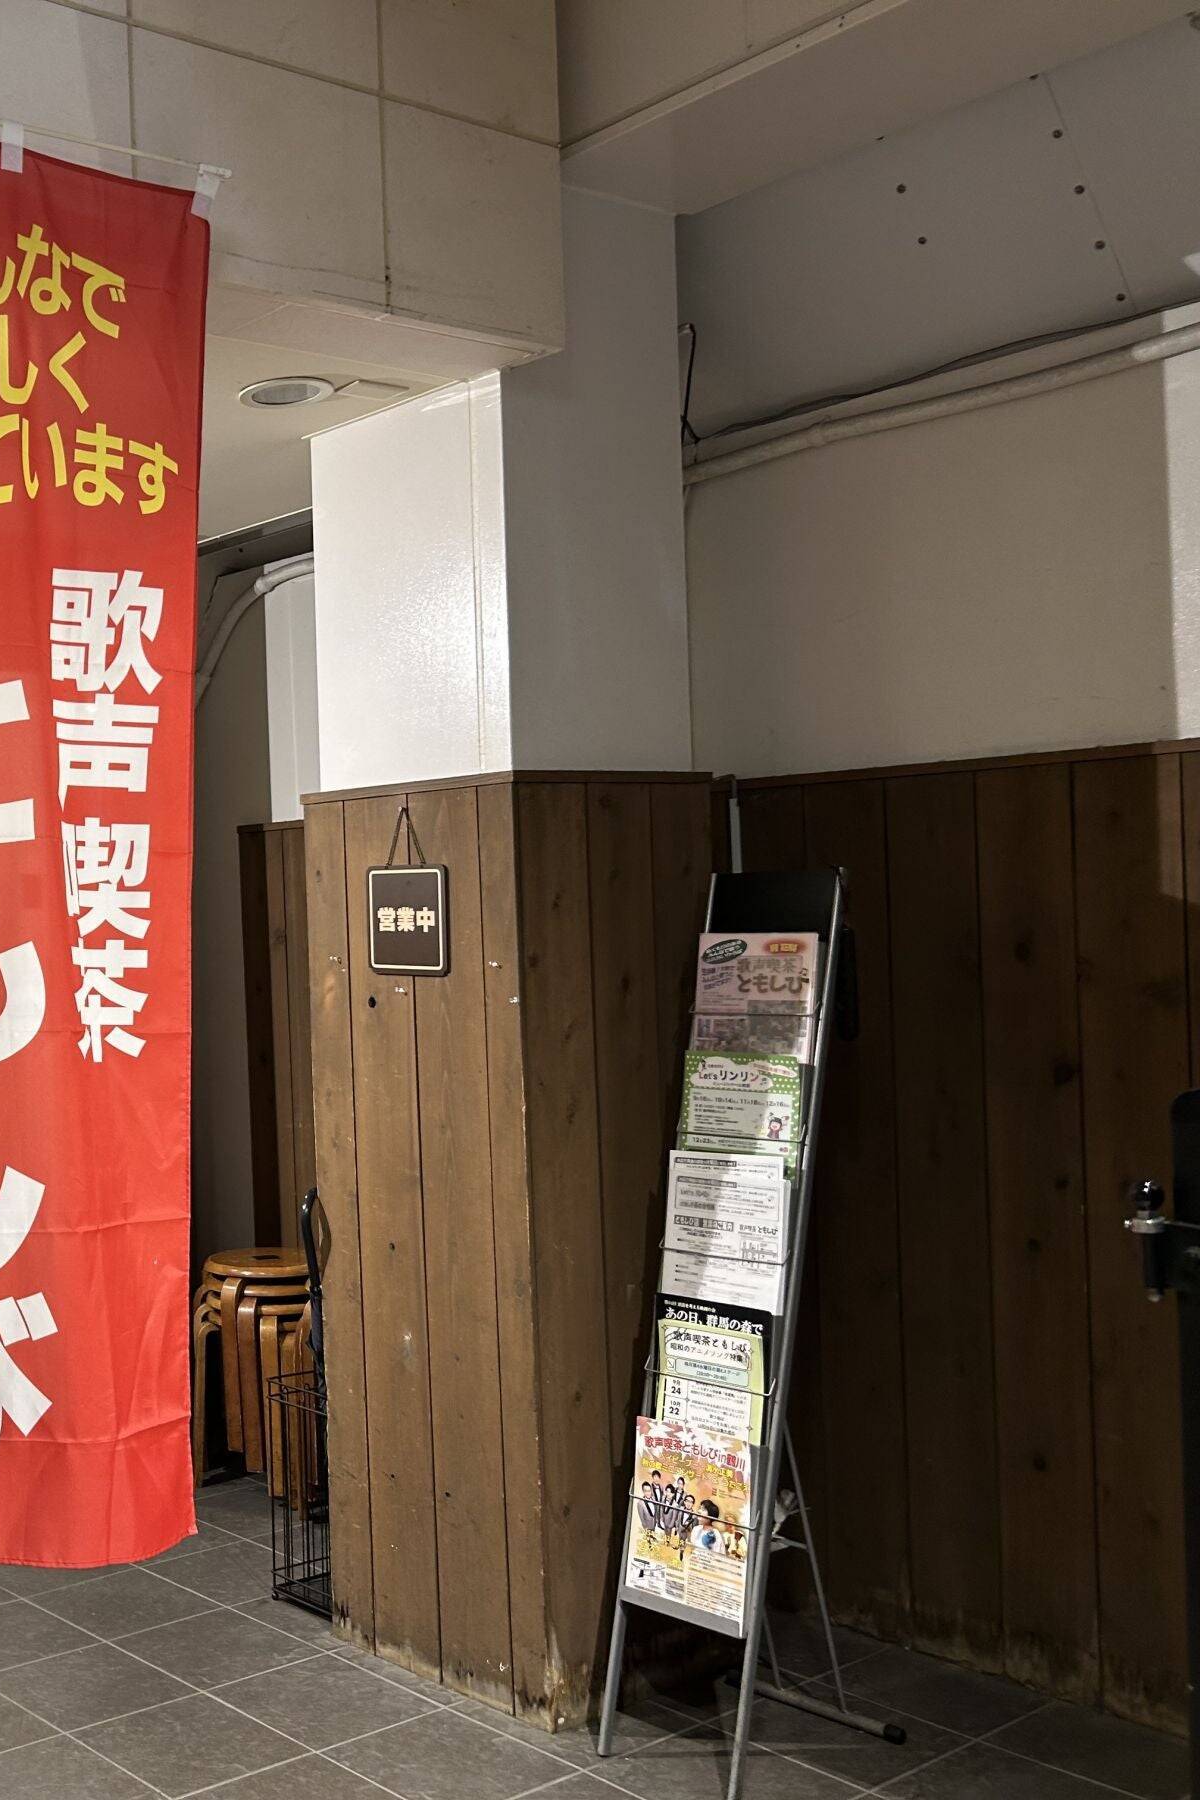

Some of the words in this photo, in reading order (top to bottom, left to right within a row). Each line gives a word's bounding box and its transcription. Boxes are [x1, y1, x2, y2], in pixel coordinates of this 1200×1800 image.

[50, 568, 164, 1063] 歌声喫茶
[377, 906, 436, 933] 営業中
[737, 957, 797, 974] 歌声喫茶
[737, 972, 810, 995] ともしび
[665, 1307, 763, 1335] あの日、群馬の森で
[673, 1330, 746, 1353] 歌声喫茶ともしび
[671, 1386, 681, 1394] 24
[669, 1406, 680, 1415] 22
